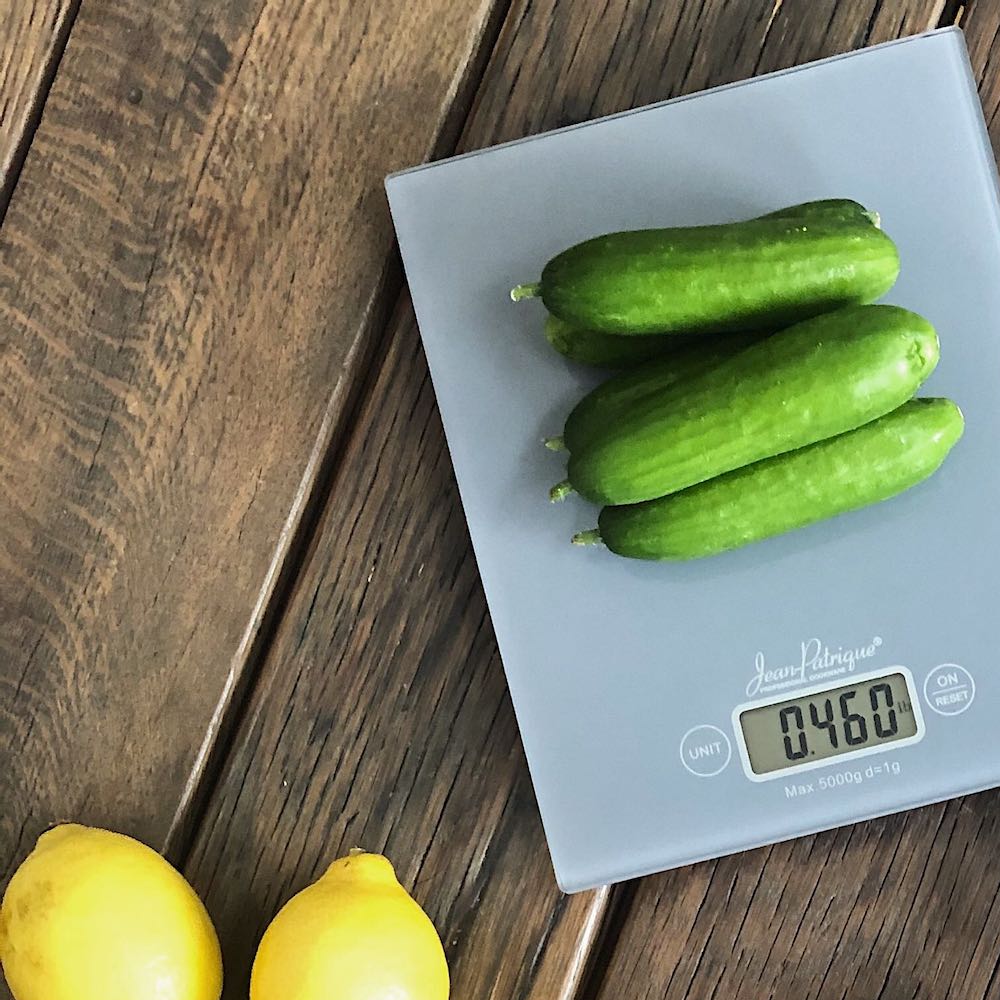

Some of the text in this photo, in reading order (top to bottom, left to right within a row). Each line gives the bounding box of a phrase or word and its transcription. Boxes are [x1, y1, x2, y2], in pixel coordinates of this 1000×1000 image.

[937, 672, 959, 688] ON
[935, 690, 969, 707] RESET
[688, 742, 723, 760] UNIT
[864, 761, 901, 778] d=1g
